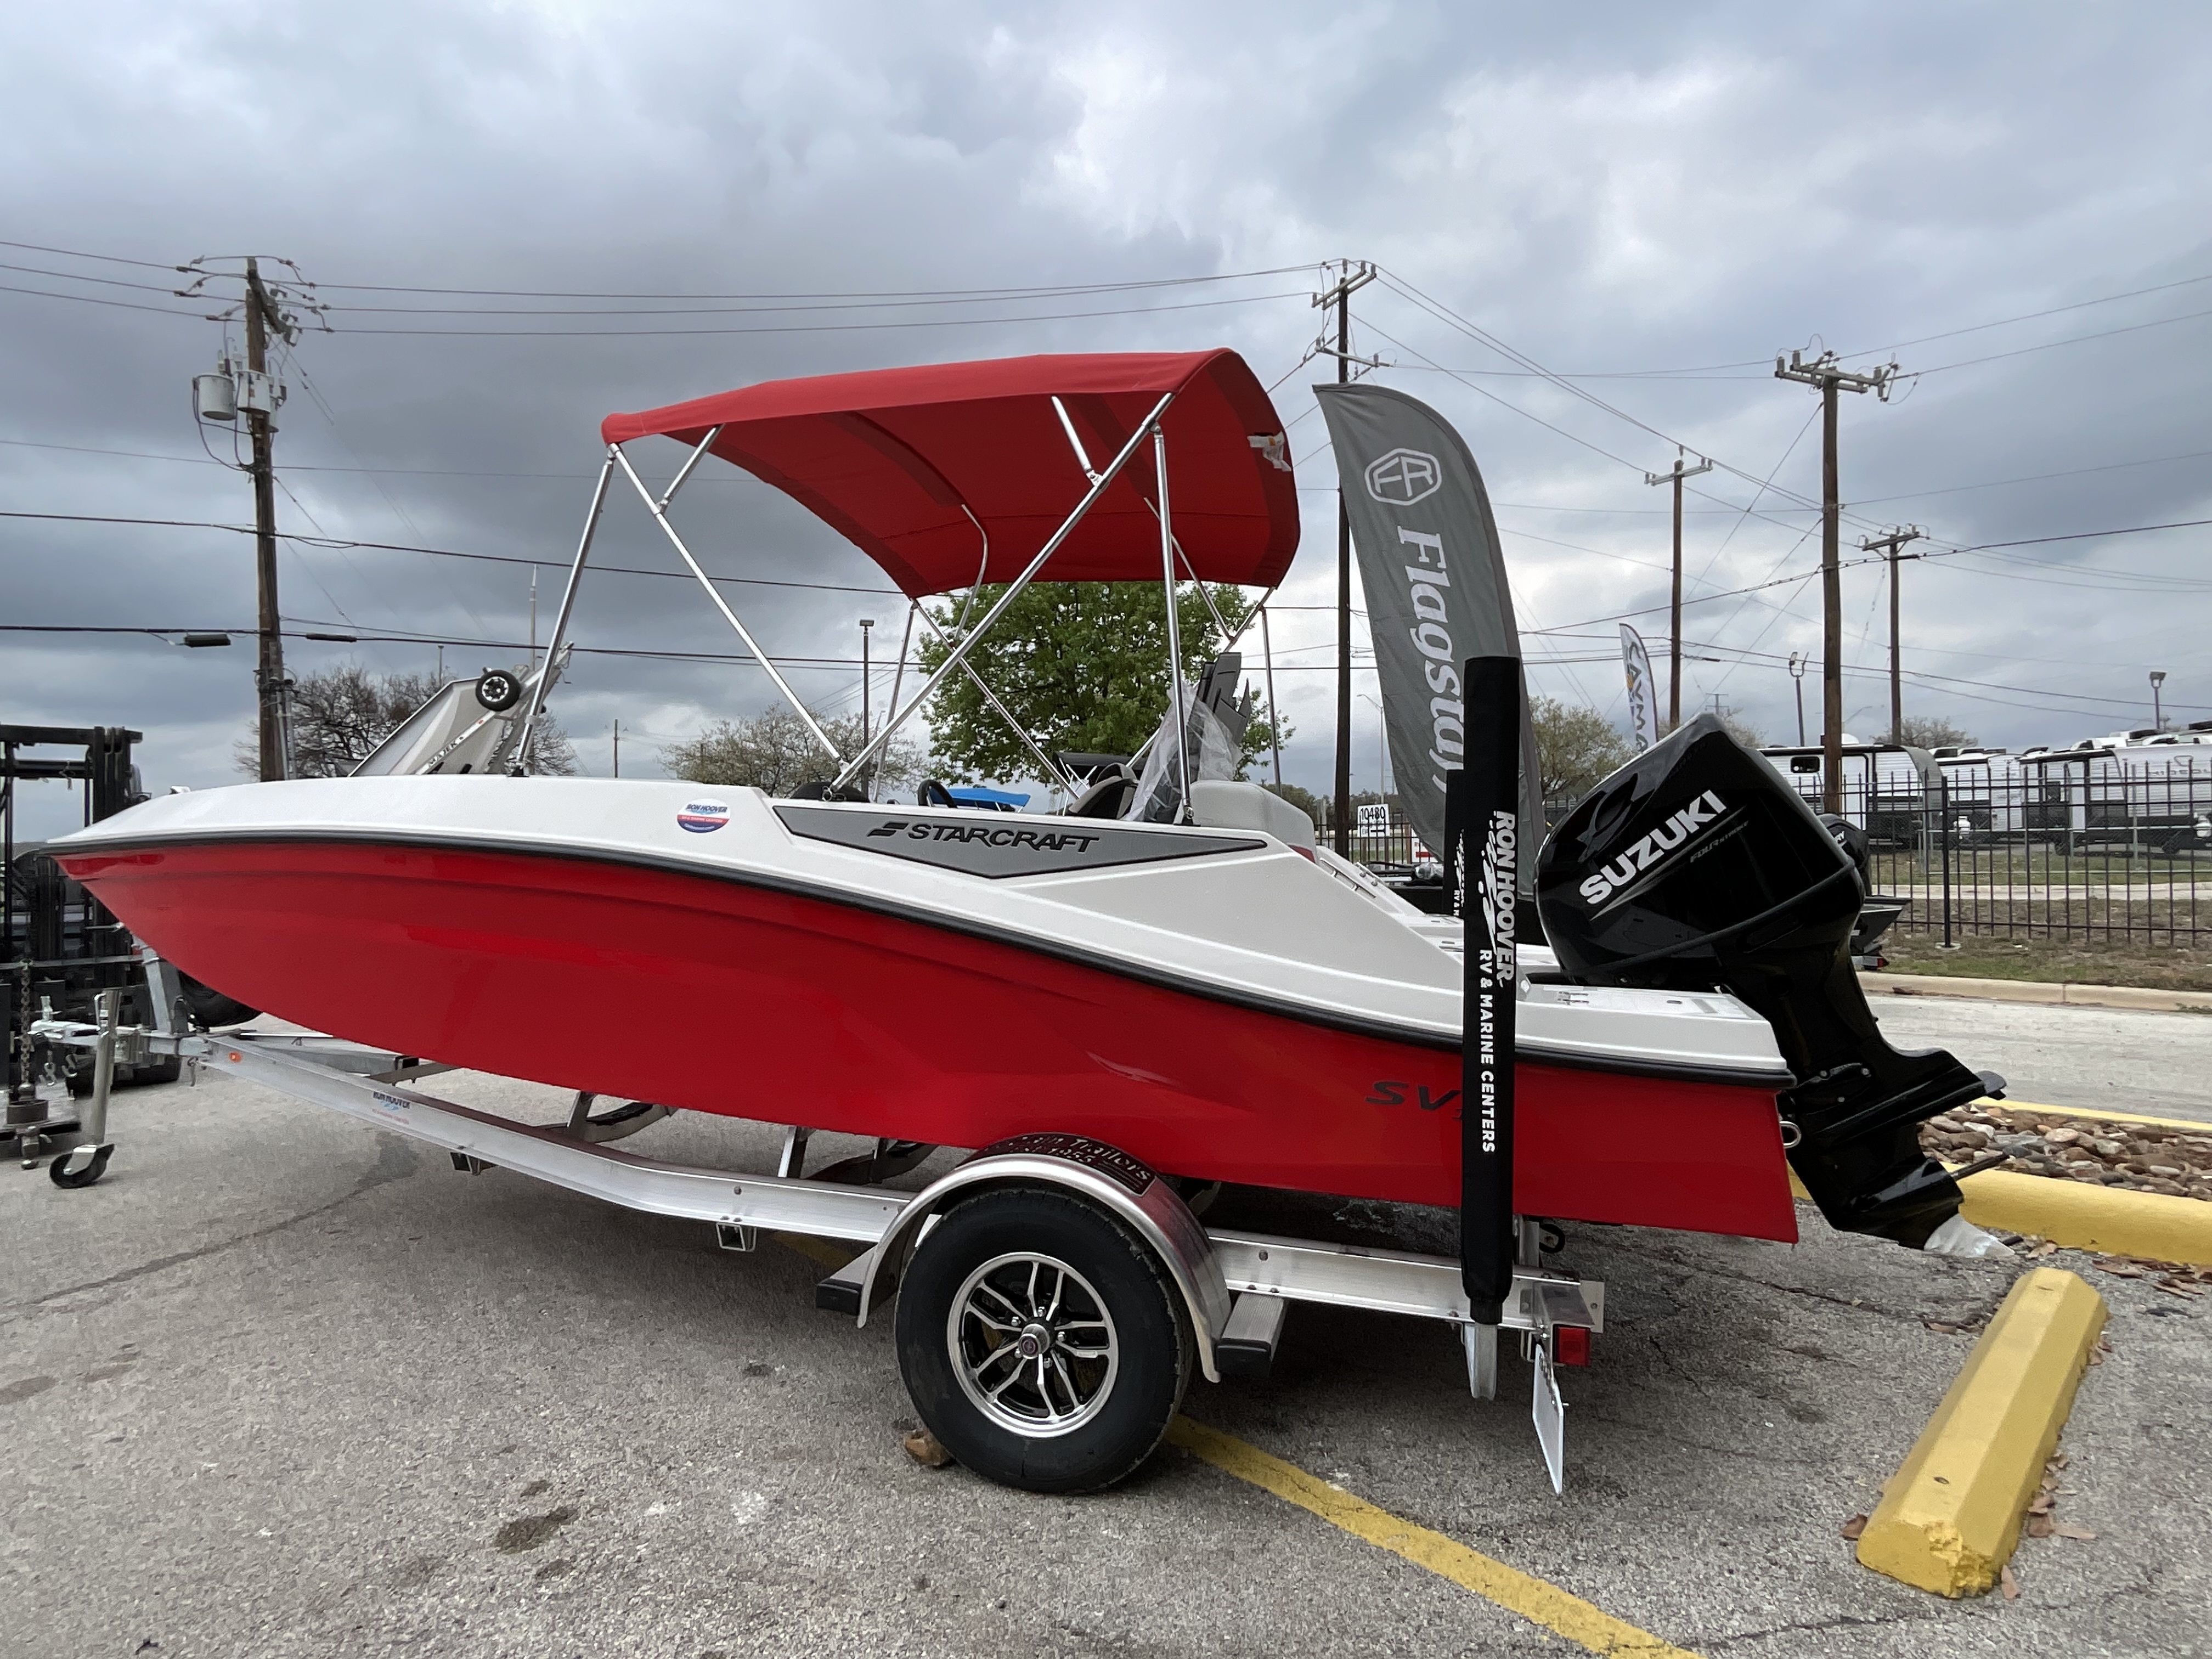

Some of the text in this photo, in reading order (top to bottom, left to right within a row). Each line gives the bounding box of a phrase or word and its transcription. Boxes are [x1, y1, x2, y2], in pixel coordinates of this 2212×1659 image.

[908, 823, 1099, 853] STARCRAFT
[1361, 806, 1386, 820] 10480
[1579, 789, 1727, 904] SUZUKI
[1496, 812, 1515, 988] RON HOOVER
[1480, 950, 1496, 1153] RV & MARINE CENTERS
